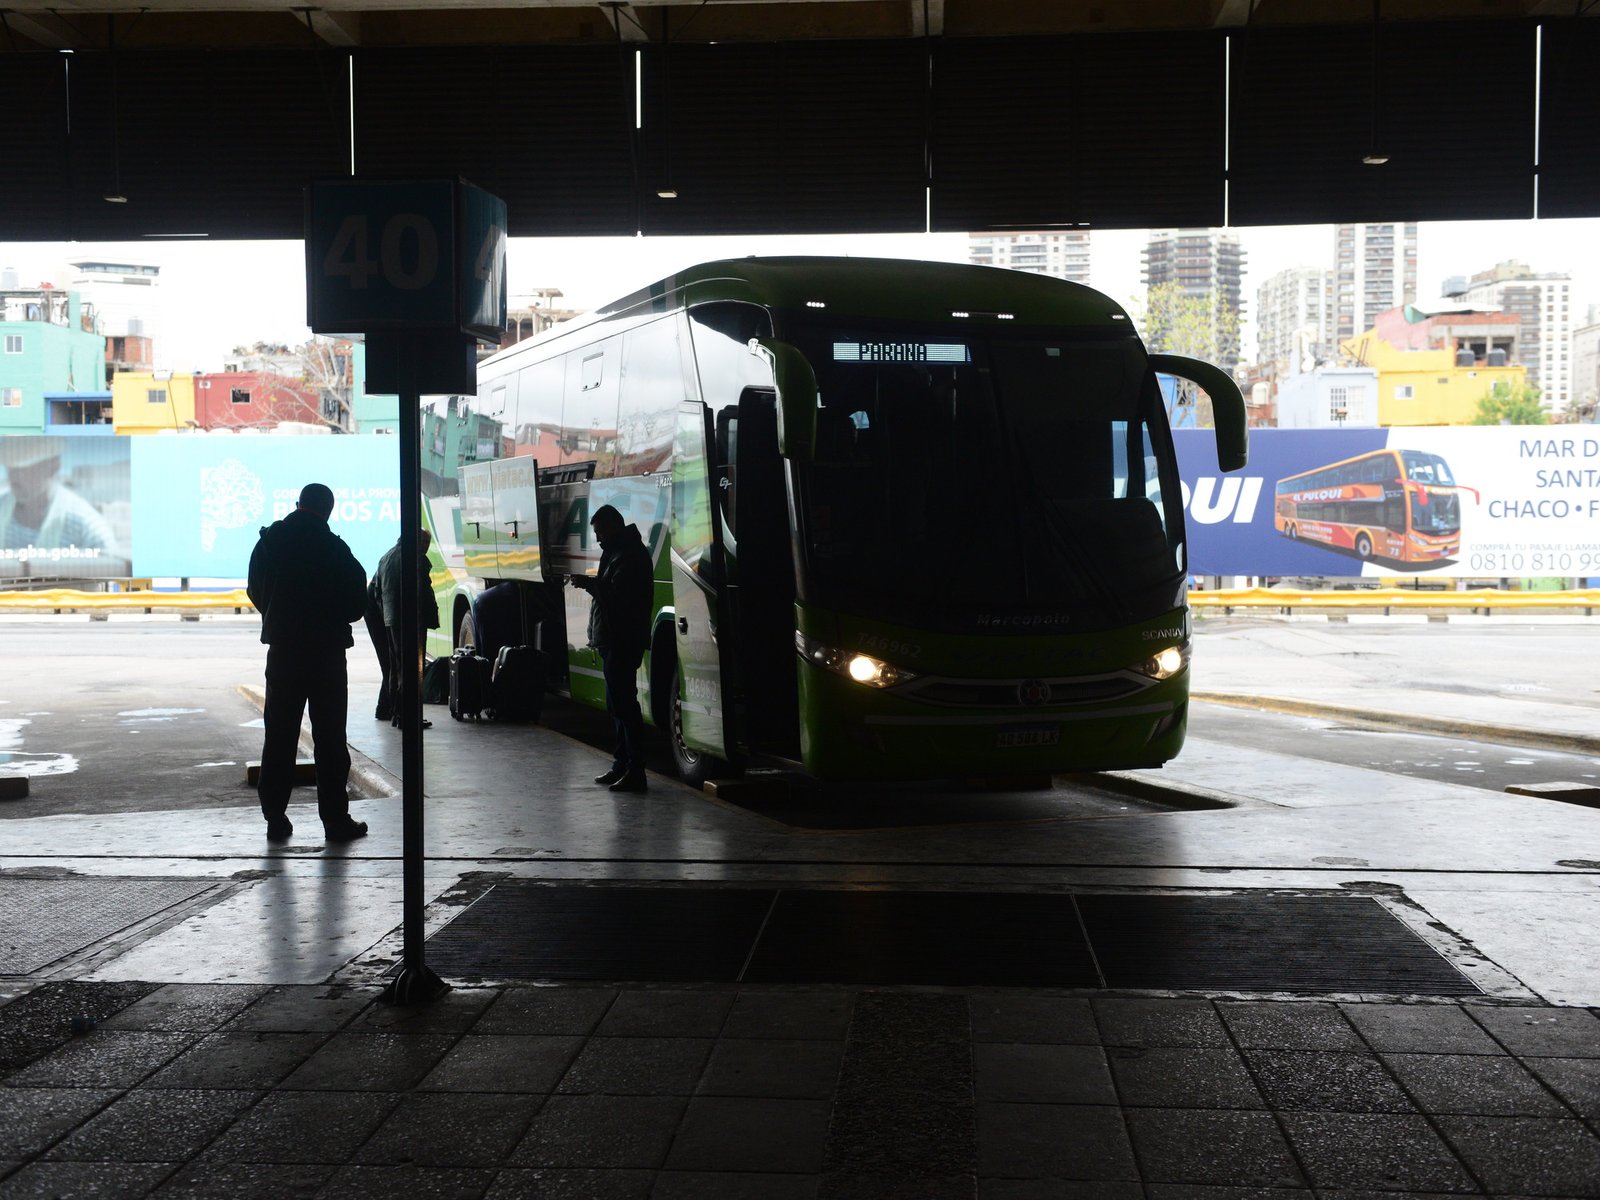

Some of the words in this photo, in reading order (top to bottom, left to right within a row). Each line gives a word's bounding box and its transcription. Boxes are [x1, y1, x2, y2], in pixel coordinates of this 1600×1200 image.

[323, 213, 439, 290] 40
[861, 343, 928, 361] PARANA
[1519, 439, 1576, 458] MAR
[352, 487, 366, 499] LA
[1488, 499, 1570, 518] CHACO
[1470, 543, 1511, 551] COMPRA
[1515, 543, 1527, 551] TU
[1529, 543, 1561, 551] PASAJE
[1470, 552, 1524, 571] 0810
[1531, 552, 1572, 571] 810
[1141, 627, 1182, 641] SCANIA
